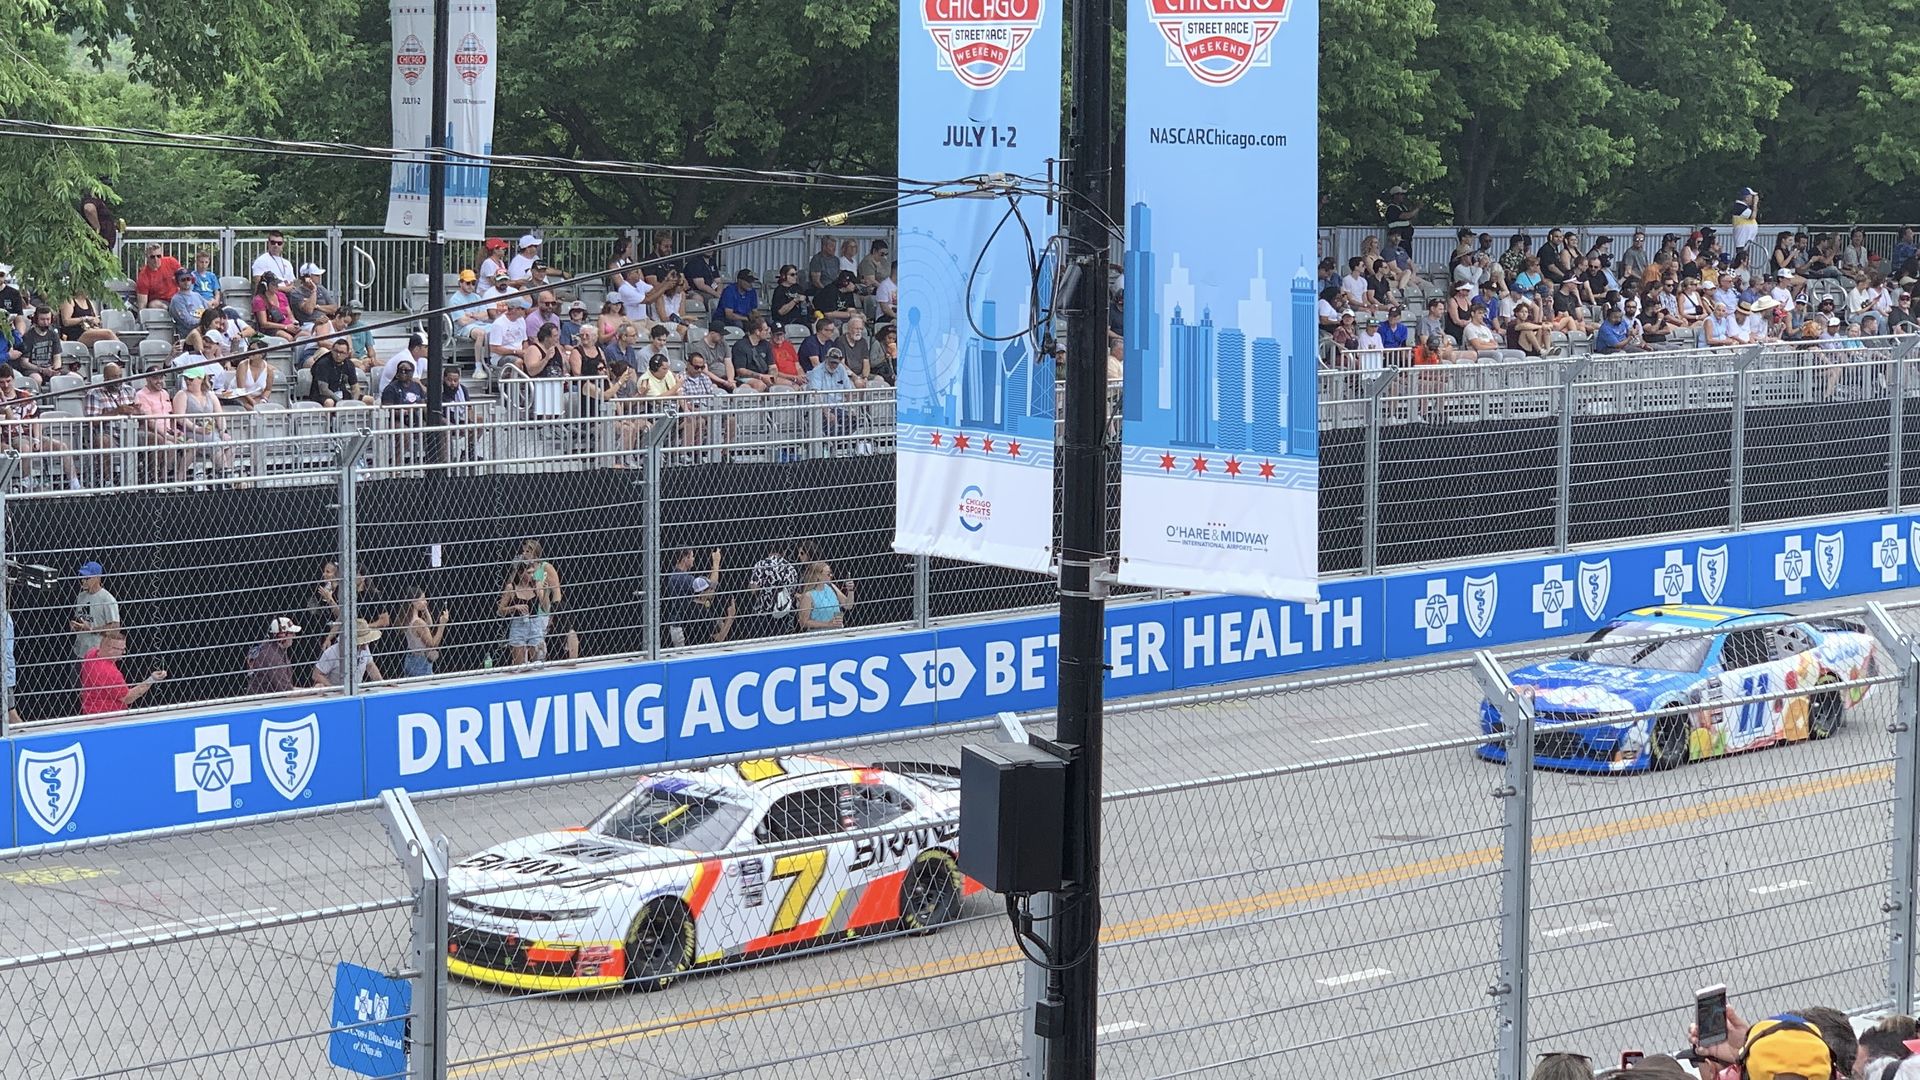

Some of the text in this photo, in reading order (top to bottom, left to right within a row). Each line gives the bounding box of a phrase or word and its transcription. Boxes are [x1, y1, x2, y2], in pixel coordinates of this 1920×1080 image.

[955, 28, 1007, 40] STREET RACE
[1187, 22, 1249, 34] STREET RACE
[956, 46, 1004, 61] WEEKEND
[1189, 41, 1245, 57] WEEKEND
[942, 125, 1017, 148] JULY 1-2
[1150, 127, 1287, 149] NASCARChicago.com
[965, 498, 991, 508] CHICAGO
[965, 505, 991, 516] SPORTS
[1166, 525, 1269, 545] O'HARE & MIDWAY
[1182, 539, 1253, 552] INTERNATIONAL AIRPORTS
[398, 597, 1363, 776] DRIVING ACCESS to BEER HEALTH
[1738, 672, 1770, 733] 11
[768, 852, 828, 937] 7
